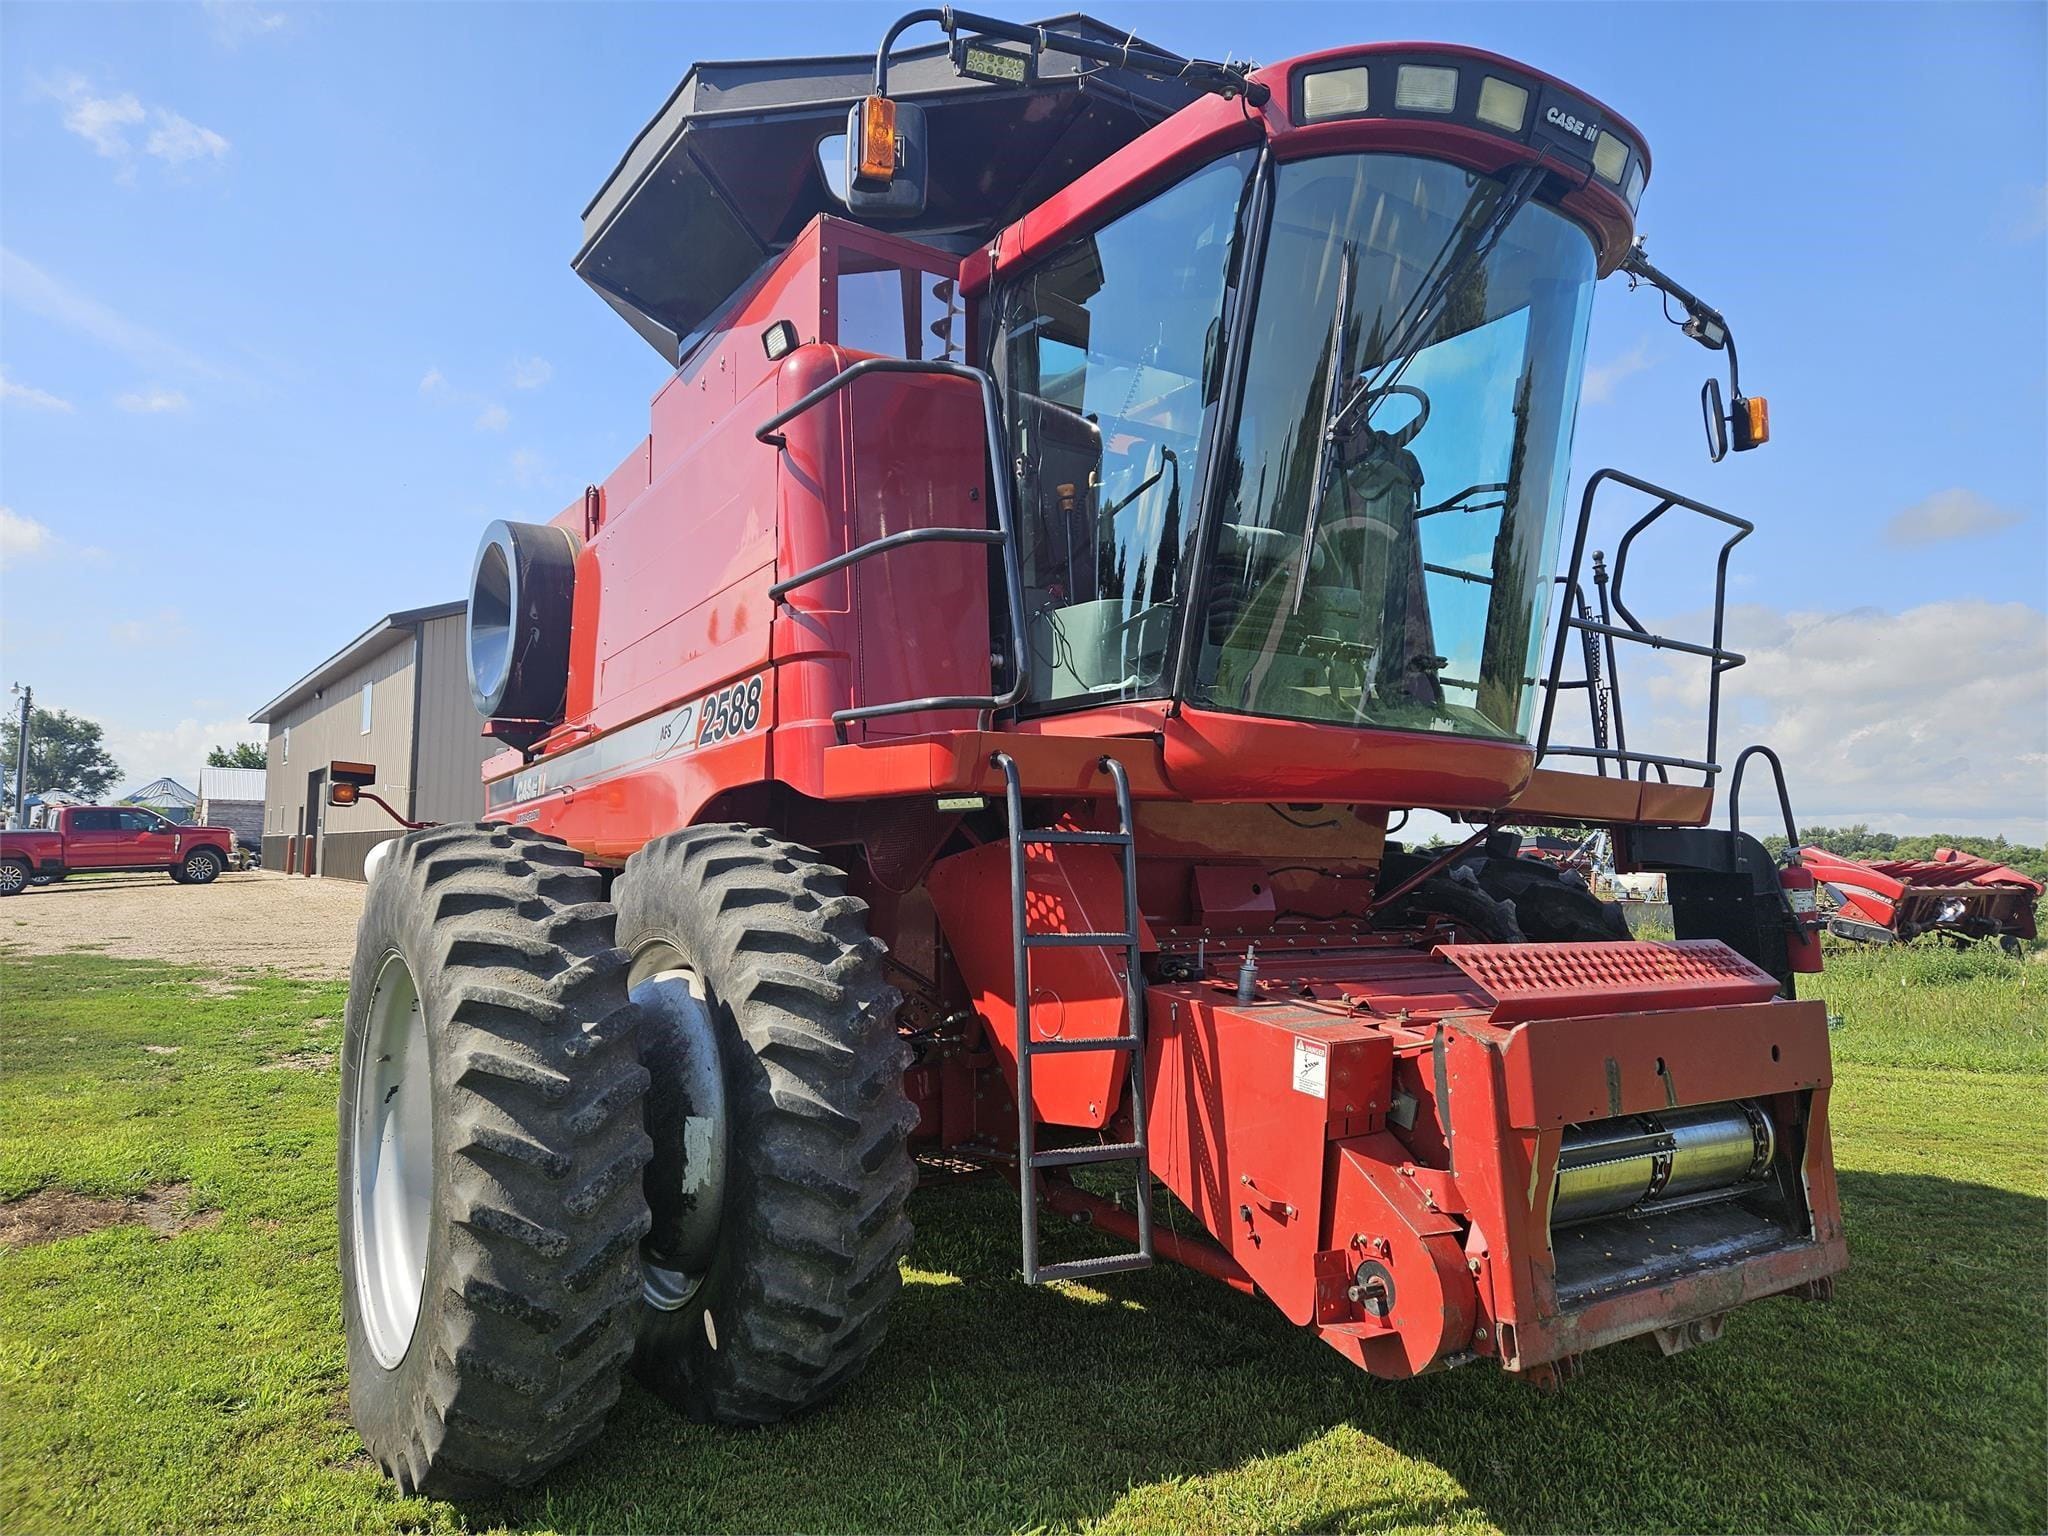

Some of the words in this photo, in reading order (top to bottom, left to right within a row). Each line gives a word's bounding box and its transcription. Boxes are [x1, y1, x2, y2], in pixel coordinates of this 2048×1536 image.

[1546, 107, 1585, 136] CASE
[699, 675, 763, 747] 2588
[516, 777, 538, 803] CASE
